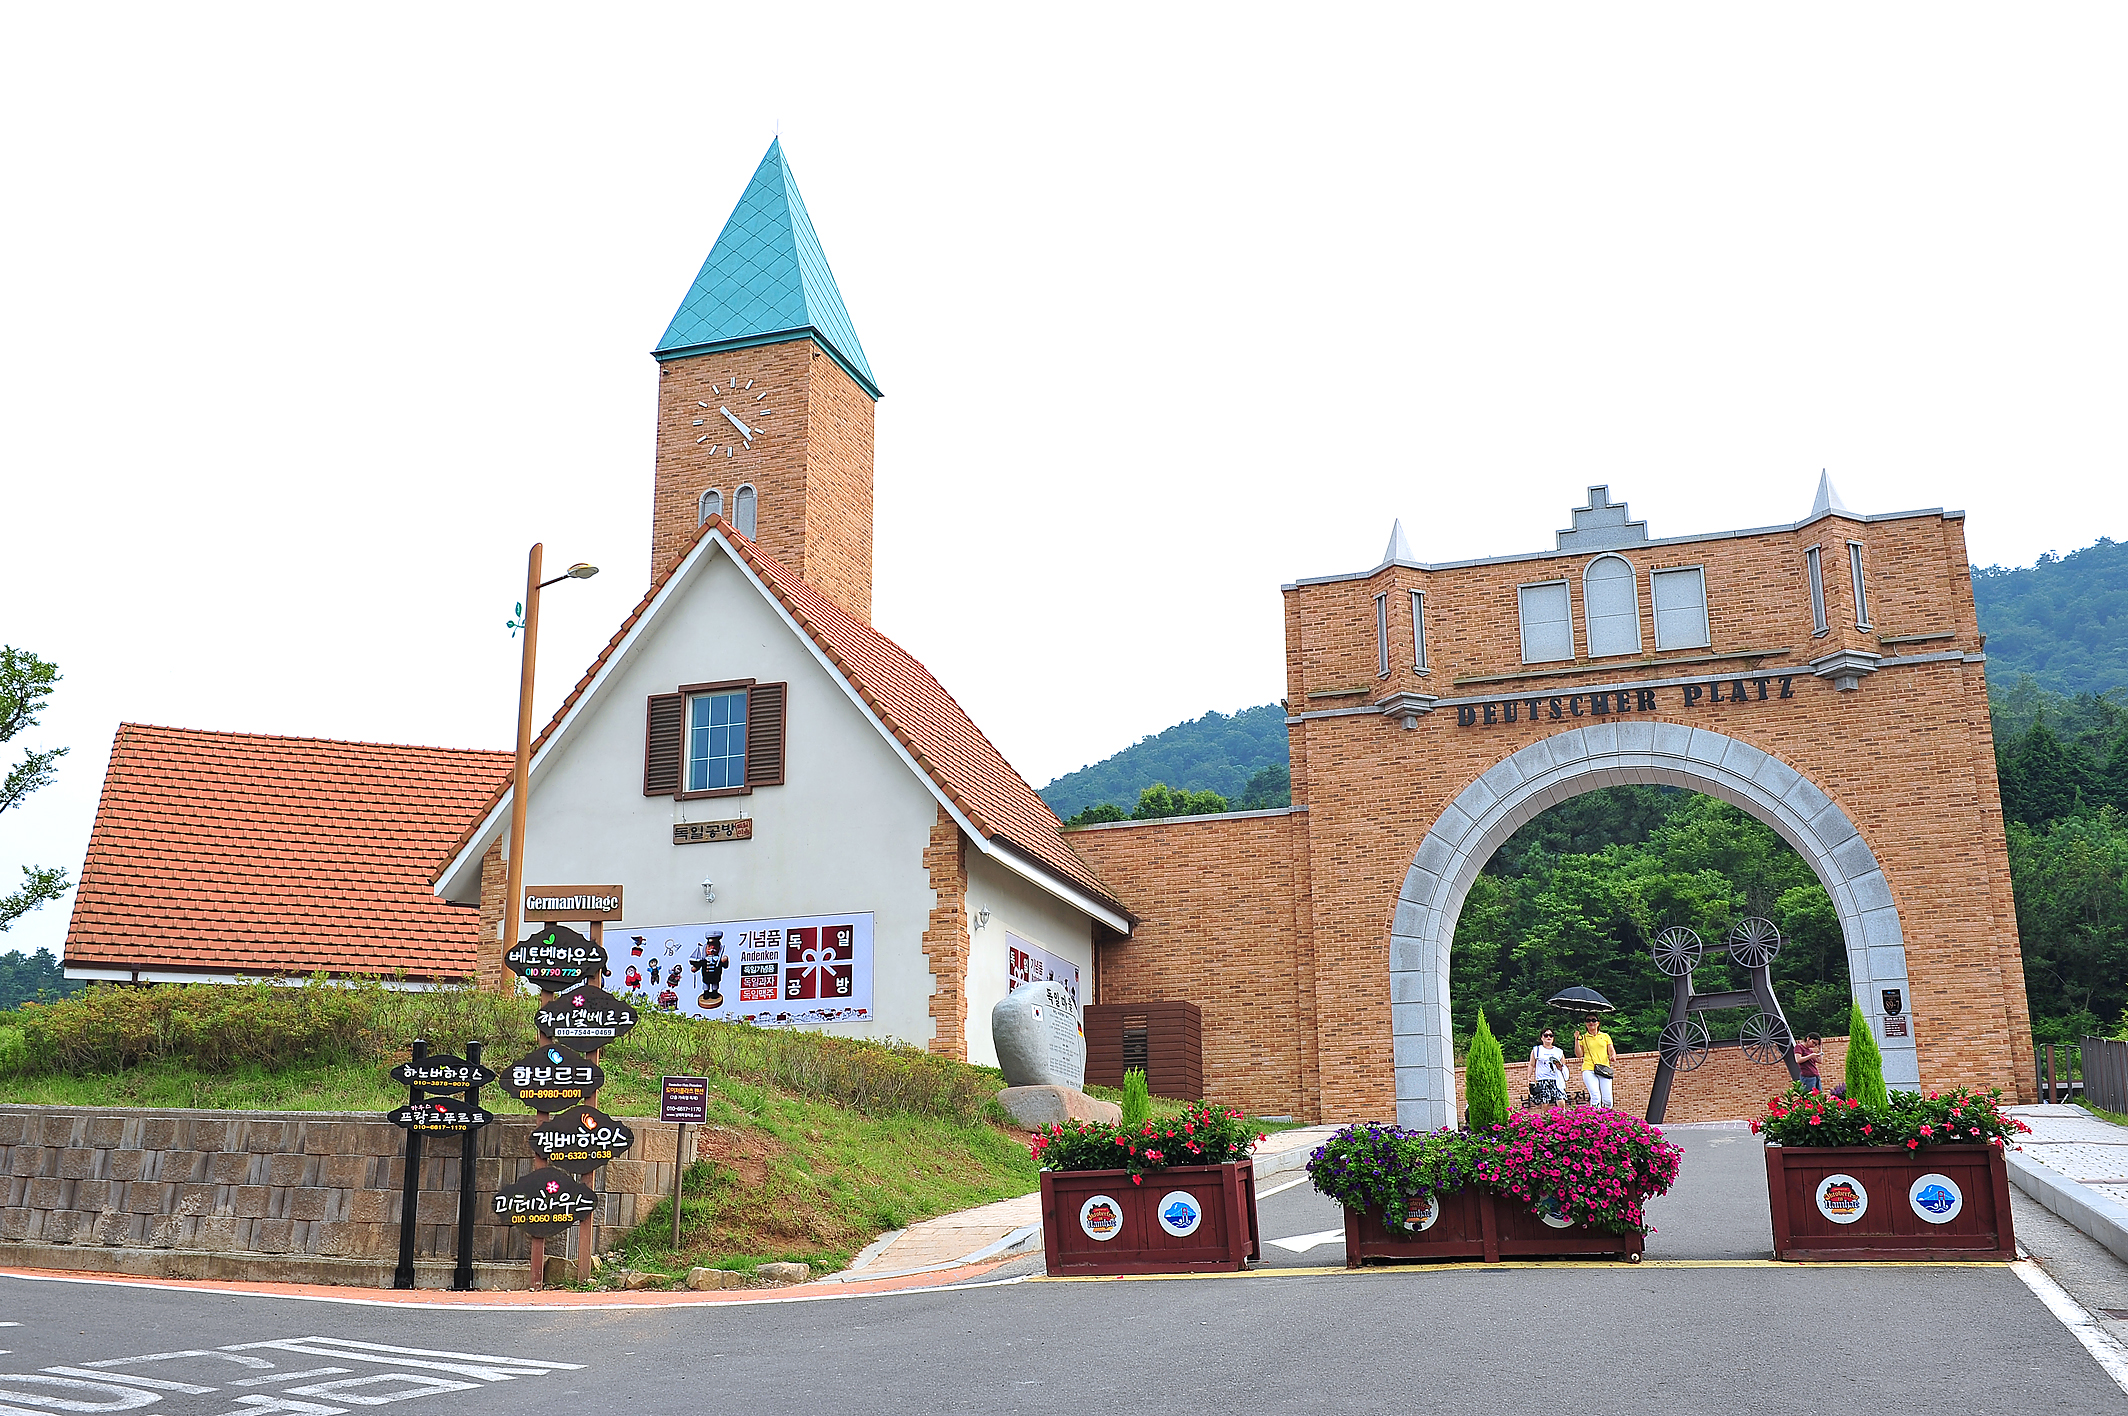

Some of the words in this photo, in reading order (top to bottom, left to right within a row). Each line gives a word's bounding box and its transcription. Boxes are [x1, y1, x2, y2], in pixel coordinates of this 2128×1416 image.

[1457, 689, 1658, 727] DEUTSCHER
[1682, 676, 1794, 707] PLATZ
[674, 823, 736, 840] 독일공방
[526, 895, 619, 912] GermanVillage
[738, 930, 781, 949] 기념품
[788, 933, 802, 950] 독
[837, 930, 849, 947] 일
[509, 946, 602, 965] 베토벤하우스
[741, 950, 779, 962] Andenken
[525, 968, 539, 977] 010
[541, 968, 560, 977] 9790
[562, 968, 582, 977] 7729
[743, 964, 775, 974] 독일기념품
[743, 976, 775, 988] 독일과자
[787, 979, 801, 996] 공
[835, 976, 849, 994] 방
[742, 988, 775, 1000] 독일맥주
[537, 1009, 635, 1027] 하이델베르크
[403, 1064, 482, 1081] 하노버하우스
[512, 1066, 594, 1086] 함부르크
[519, 1089, 582, 1099] 010-8980-0091
[399, 1110, 485, 1125] 프랑크푸르트
[533, 1127, 628, 1152] 겔베하우스
[549, 1150, 612, 1161] 010-6320-0638
[495, 1189, 594, 1216] 괴테하우스
[511, 1215, 526, 1224] 010
[528, 1214, 550, 1223] 9060
[552, 1213, 574, 1222] 8885
